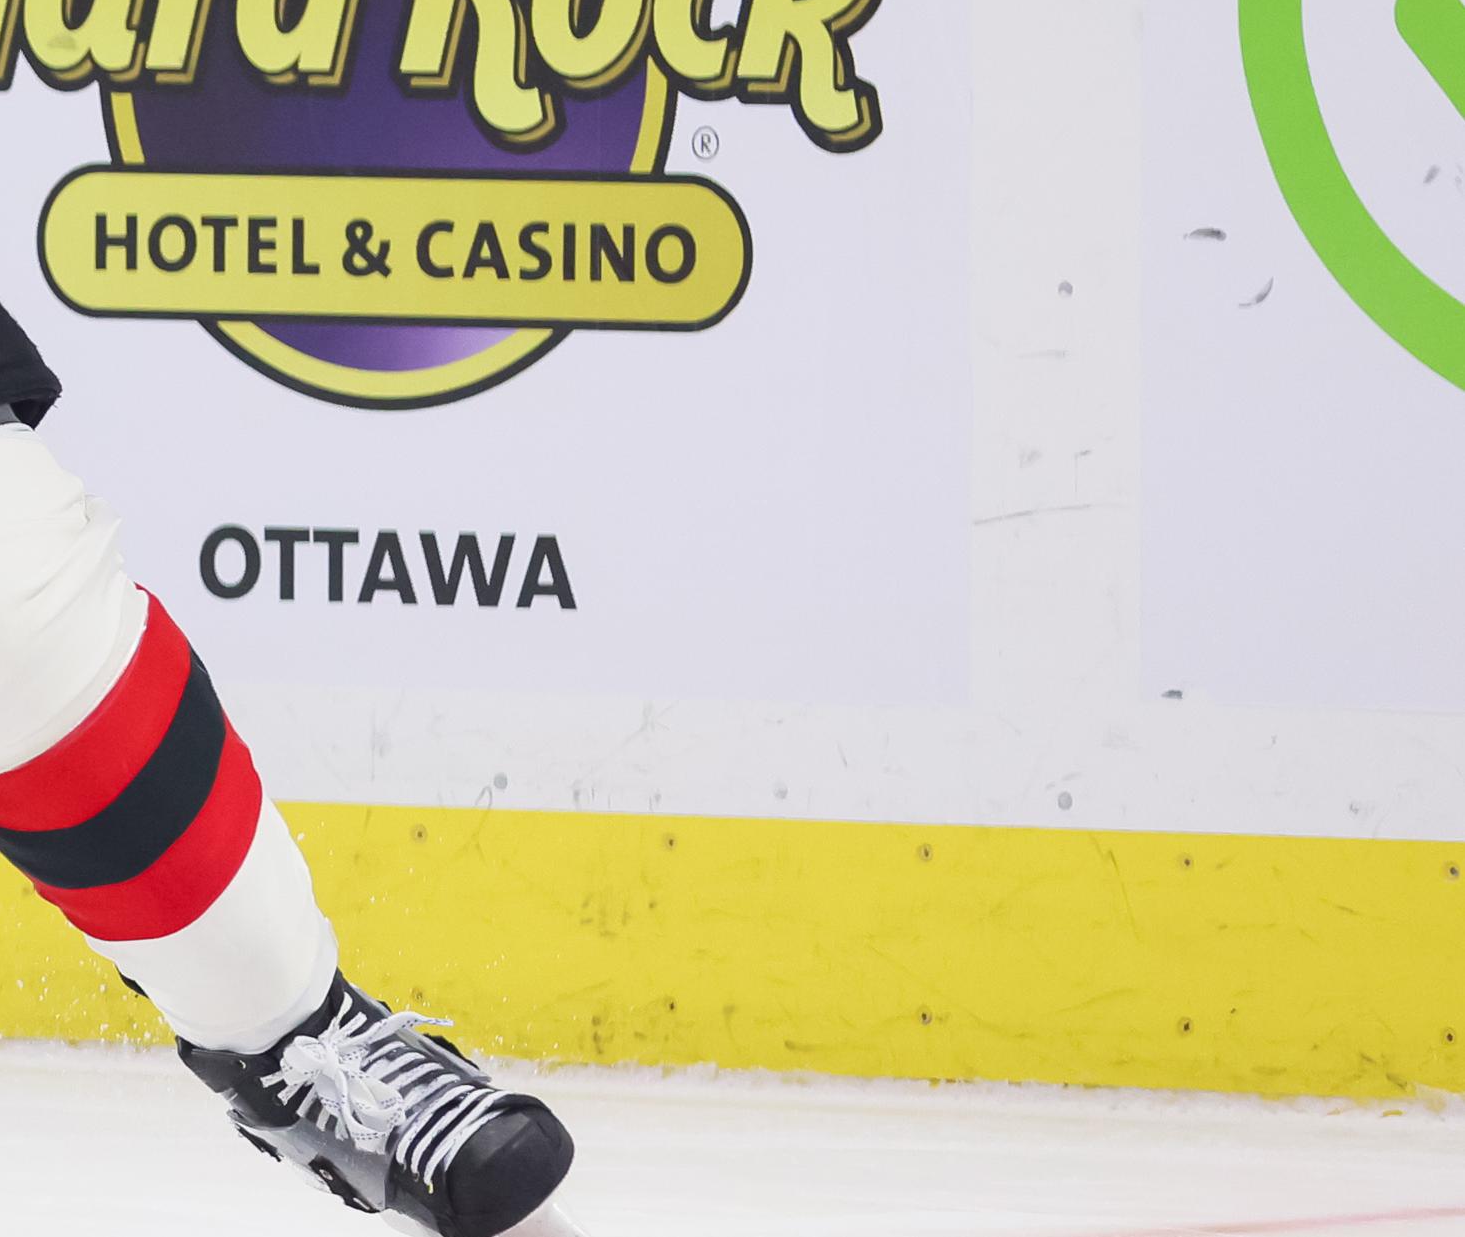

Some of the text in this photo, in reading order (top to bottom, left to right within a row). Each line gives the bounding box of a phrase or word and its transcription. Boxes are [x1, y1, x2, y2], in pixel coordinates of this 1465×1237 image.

[91, 213, 699, 286] HOTEL & CASINO
[197, 523, 578, 610] OTTAWA
